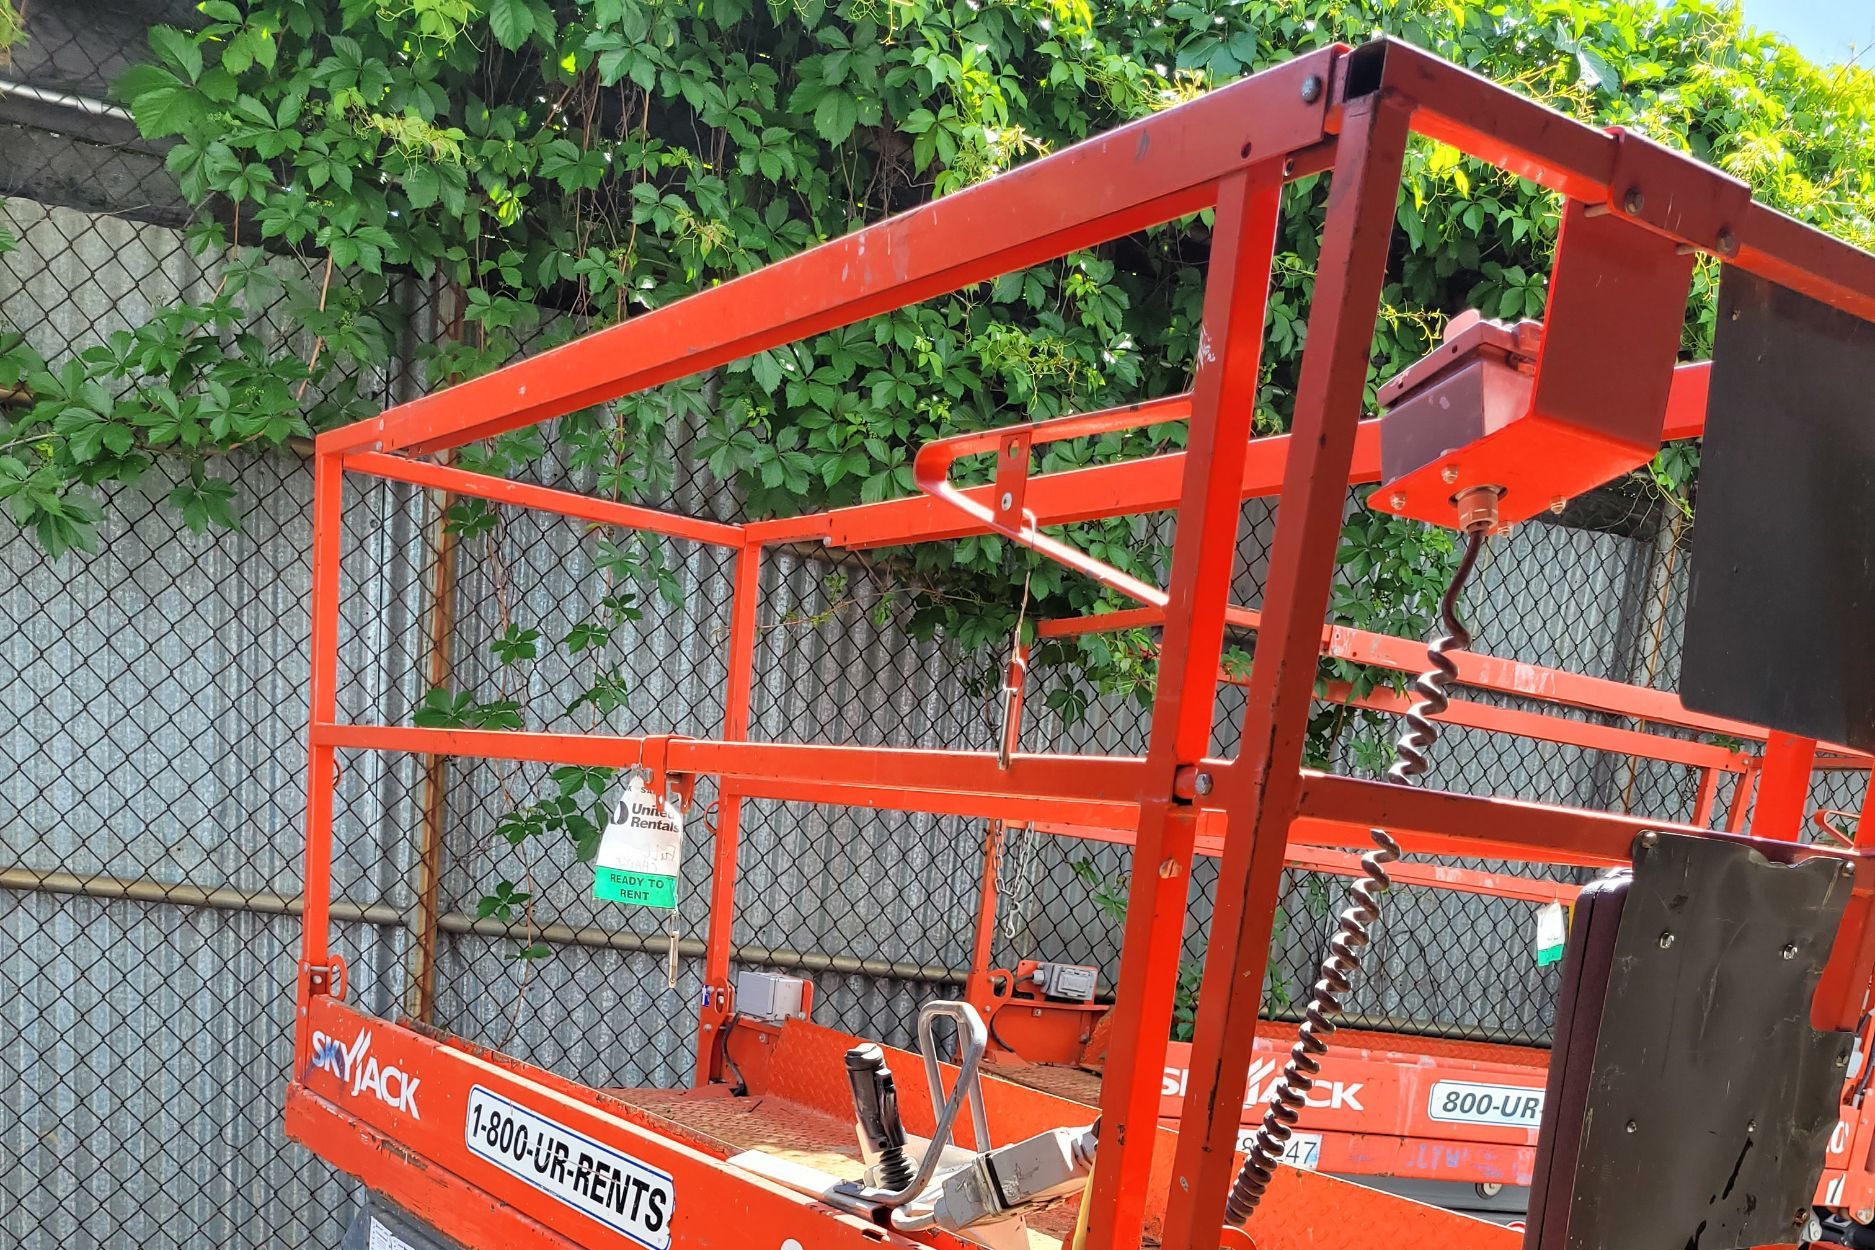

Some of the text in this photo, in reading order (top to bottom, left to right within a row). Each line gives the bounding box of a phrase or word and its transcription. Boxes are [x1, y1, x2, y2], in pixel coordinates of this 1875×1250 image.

[630, 817, 680, 834] Rentals
[610, 873, 665, 890] READY TO
[620, 889, 650, 901] RENT
[312, 1027, 421, 1120] SKYJACK
[1442, 1091, 1542, 1119] 800-UR
[472, 1103, 667, 1233] 1-800-UR-RENTS
